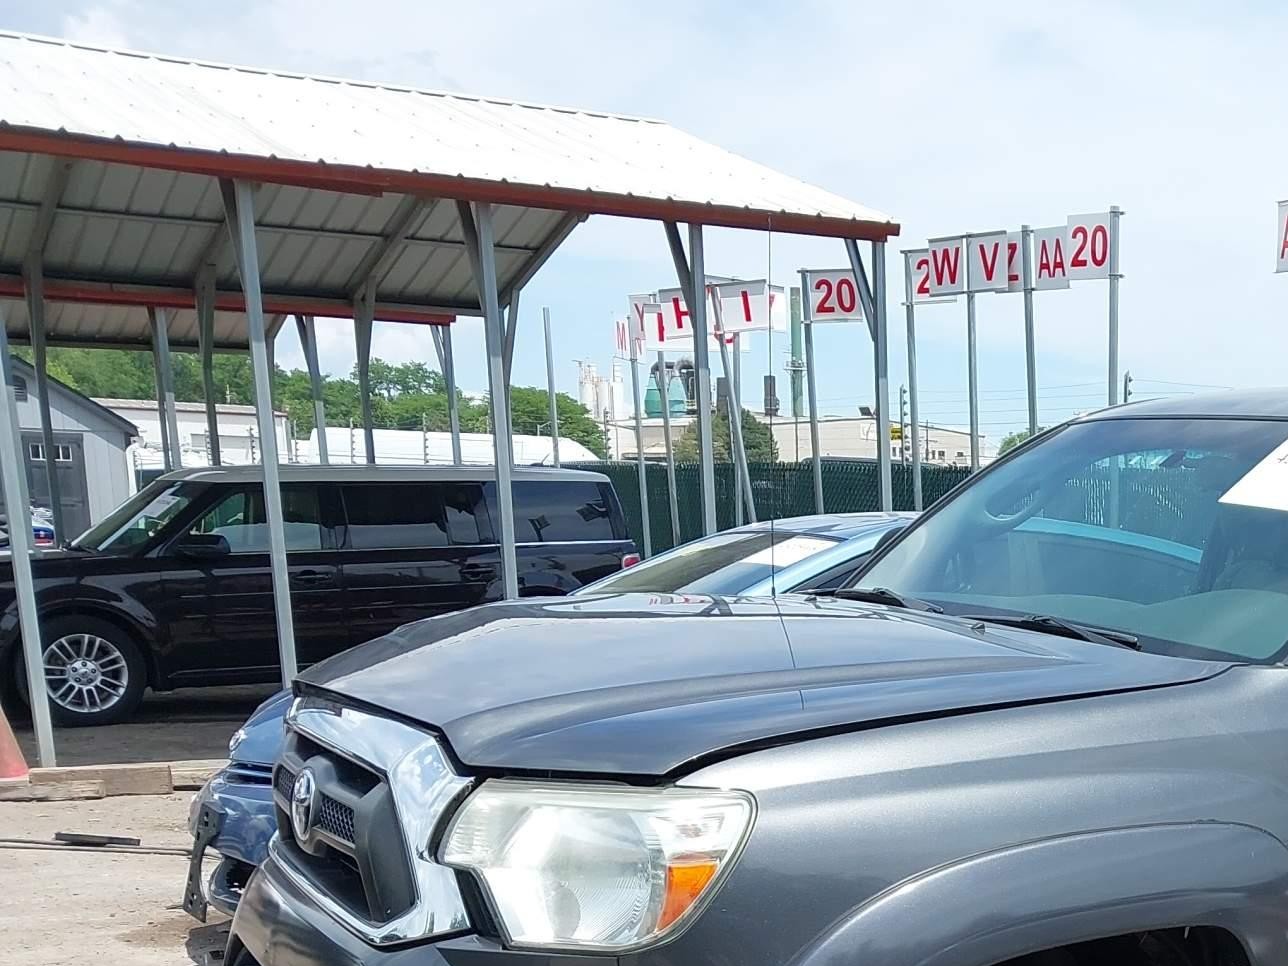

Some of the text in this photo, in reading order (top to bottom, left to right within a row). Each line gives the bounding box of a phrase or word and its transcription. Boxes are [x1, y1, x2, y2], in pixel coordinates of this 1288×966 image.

[932, 246, 960, 286] W
[978, 242, 1000, 282] V
[1038, 238, 1066, 279] AA
[1070, 224, 1109, 269] 20
[815, 278, 856, 314] 20
